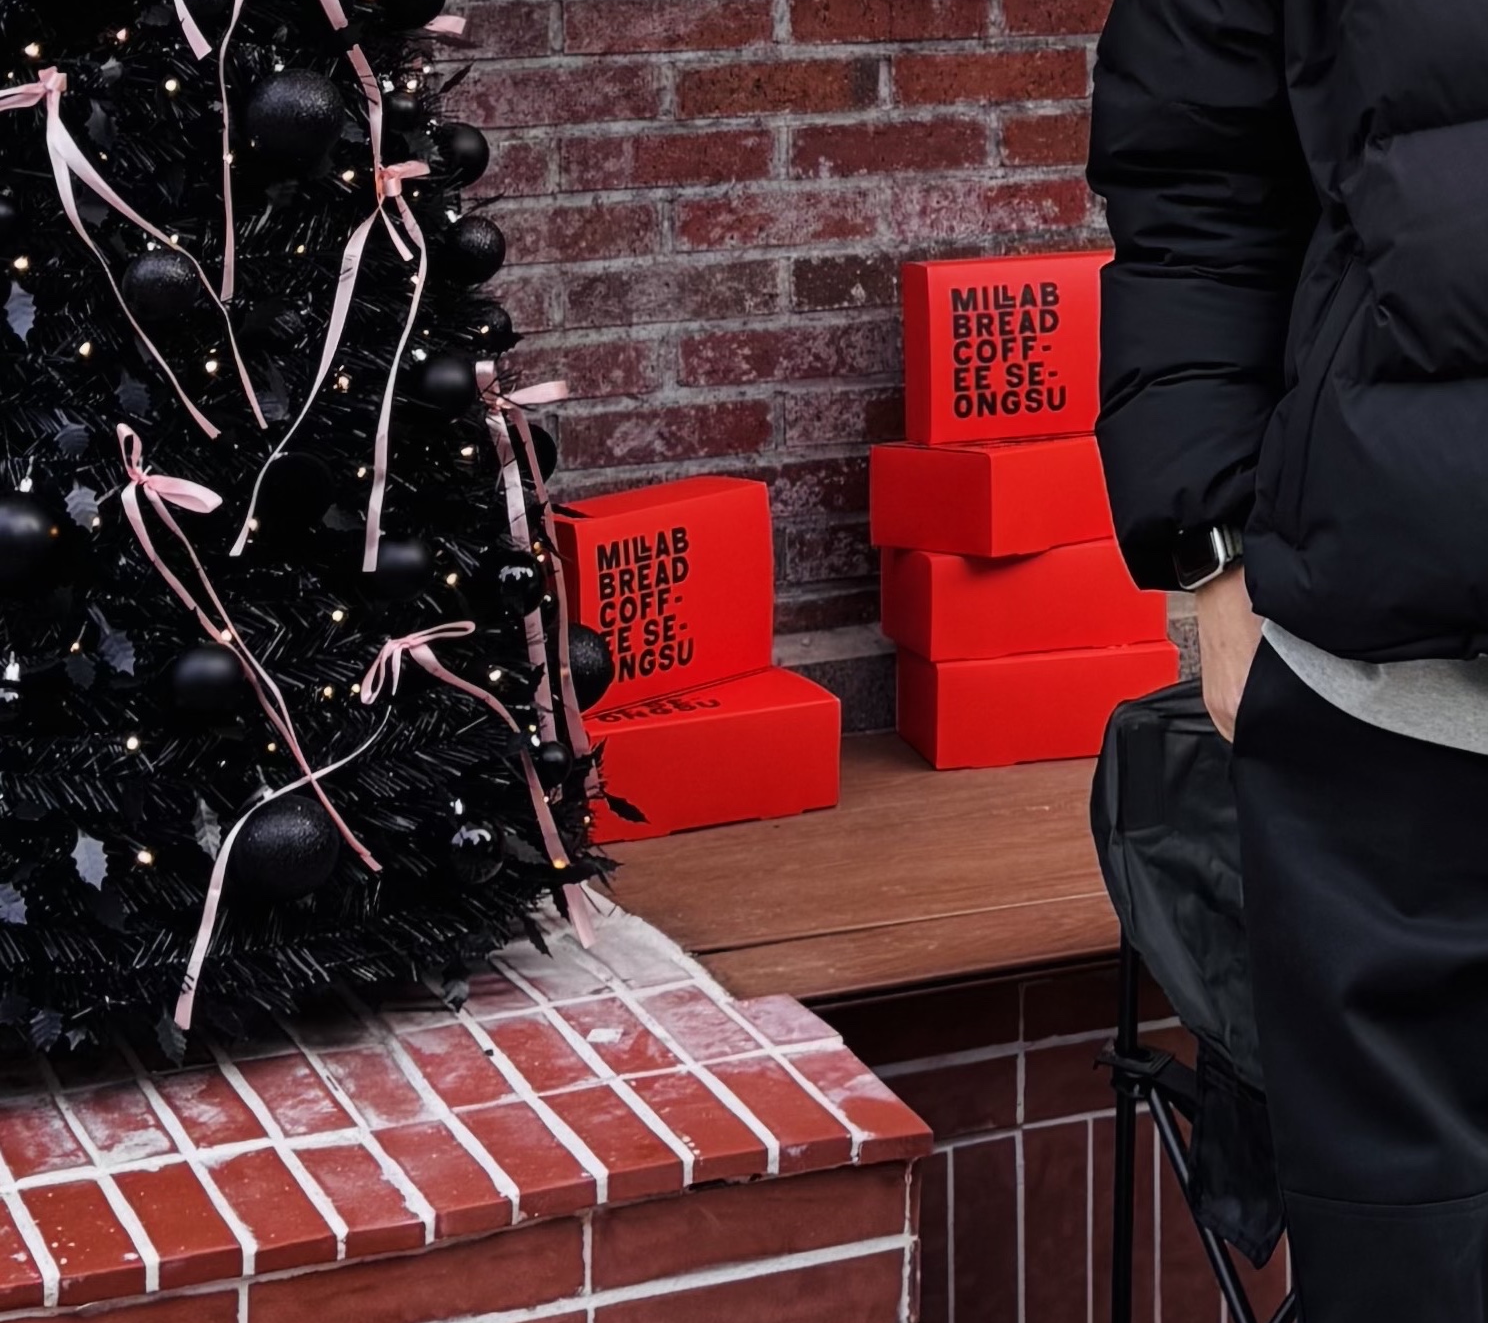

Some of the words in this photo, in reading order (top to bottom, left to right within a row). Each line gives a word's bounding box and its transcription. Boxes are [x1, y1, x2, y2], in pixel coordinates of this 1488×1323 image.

[951, 282, 1059, 313] MILLAB
[952, 308, 1059, 340] BREAD
[953, 335, 1051, 367] COFF-
[953, 365, 991, 393] EE
[1005, 362, 1058, 389] SE-
[953, 385, 1066, 419] ONGSU
[596, 527, 689, 573] MILLAB
[598, 555, 689, 601] BREAD
[599, 587, 683, 629] COFF-
[643, 614, 688, 647] SE-
[616, 638, 694, 683] NGSU
